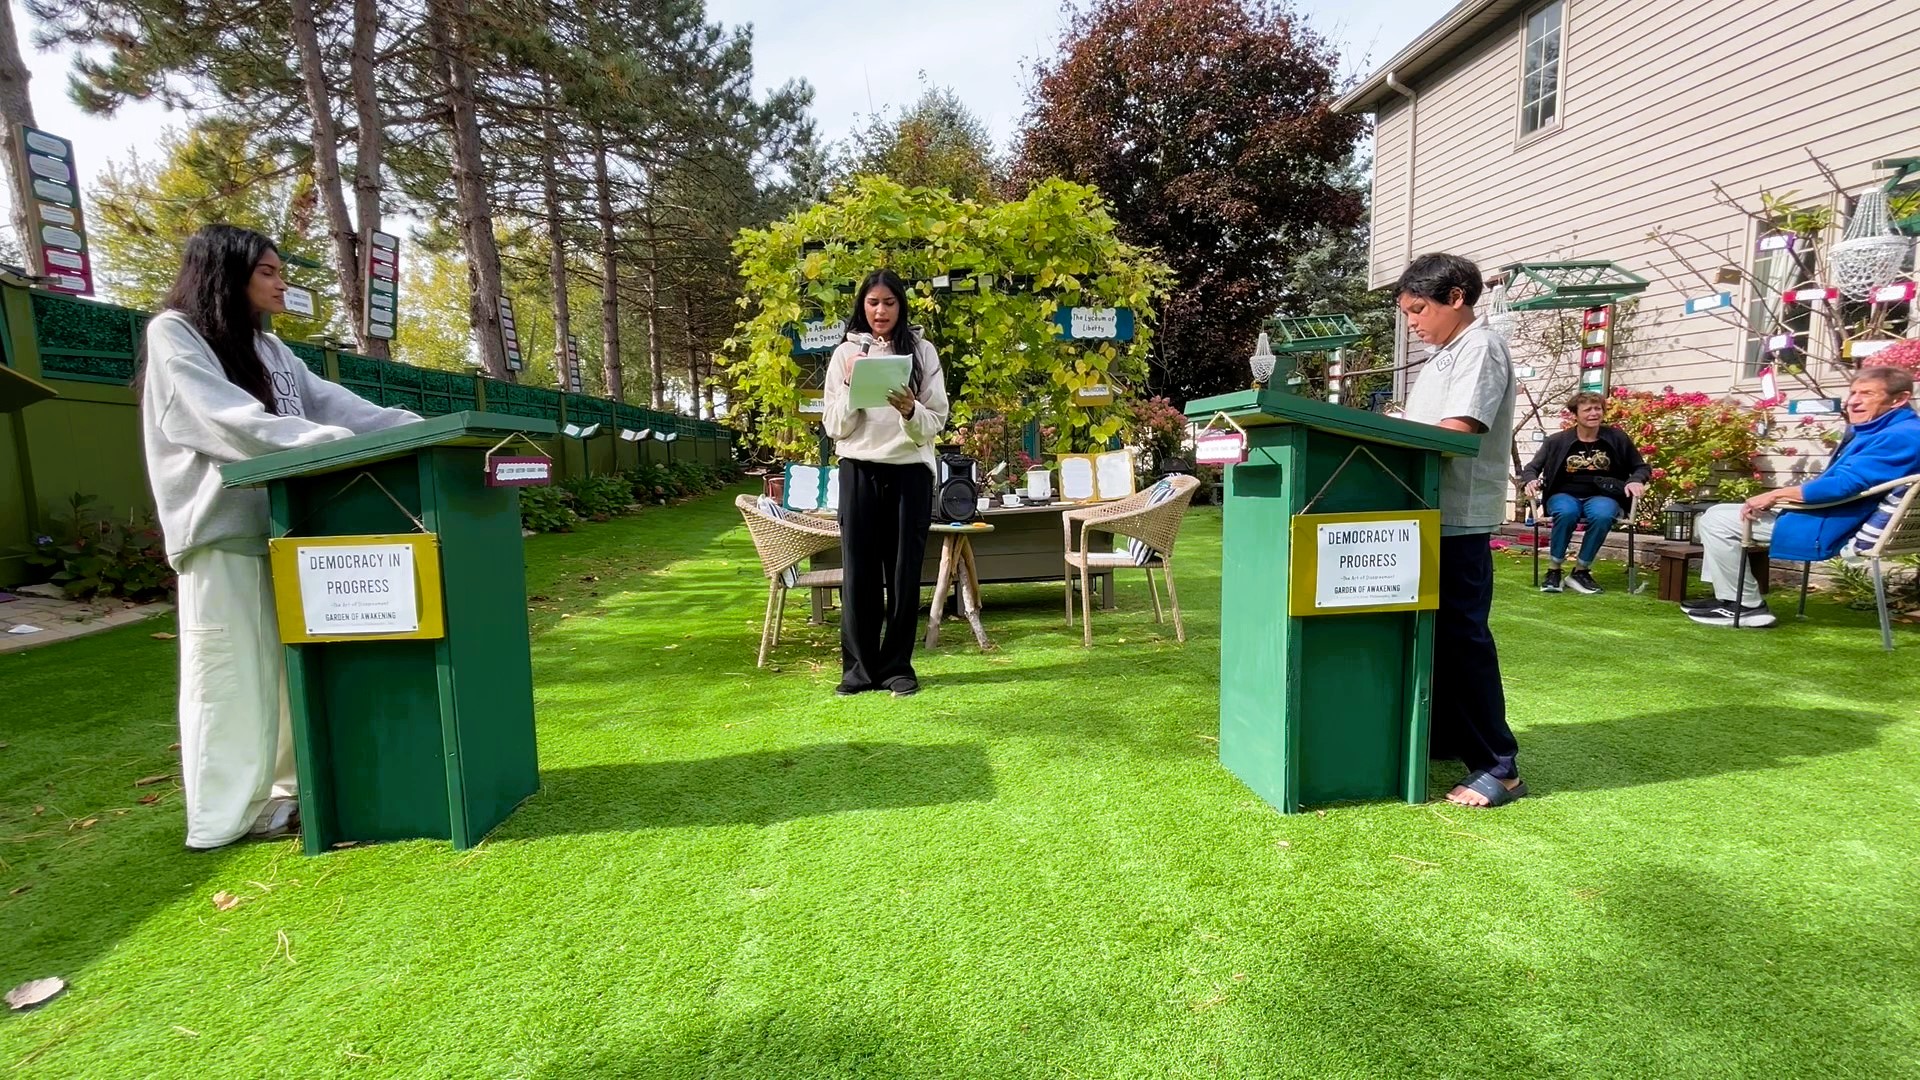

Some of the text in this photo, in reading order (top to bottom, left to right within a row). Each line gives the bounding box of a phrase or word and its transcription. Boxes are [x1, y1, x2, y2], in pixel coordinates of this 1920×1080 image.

[1073, 313, 1083, 321] The
[1082, 324, 1105, 333] Liberty
[819, 333, 843, 342] Speech
[1328, 528, 1410, 545] DEMOCRACY IN
[310, 552, 401, 570] DEMOCRACY IN
[1339, 553, 1397, 569] PROGRESS
[327, 578, 390, 595] PROGRESS
[1334, 584, 1401, 594] GARDEN OF AWAKENING
[325, 611, 397, 622] GARDEN OF AWAKENING
